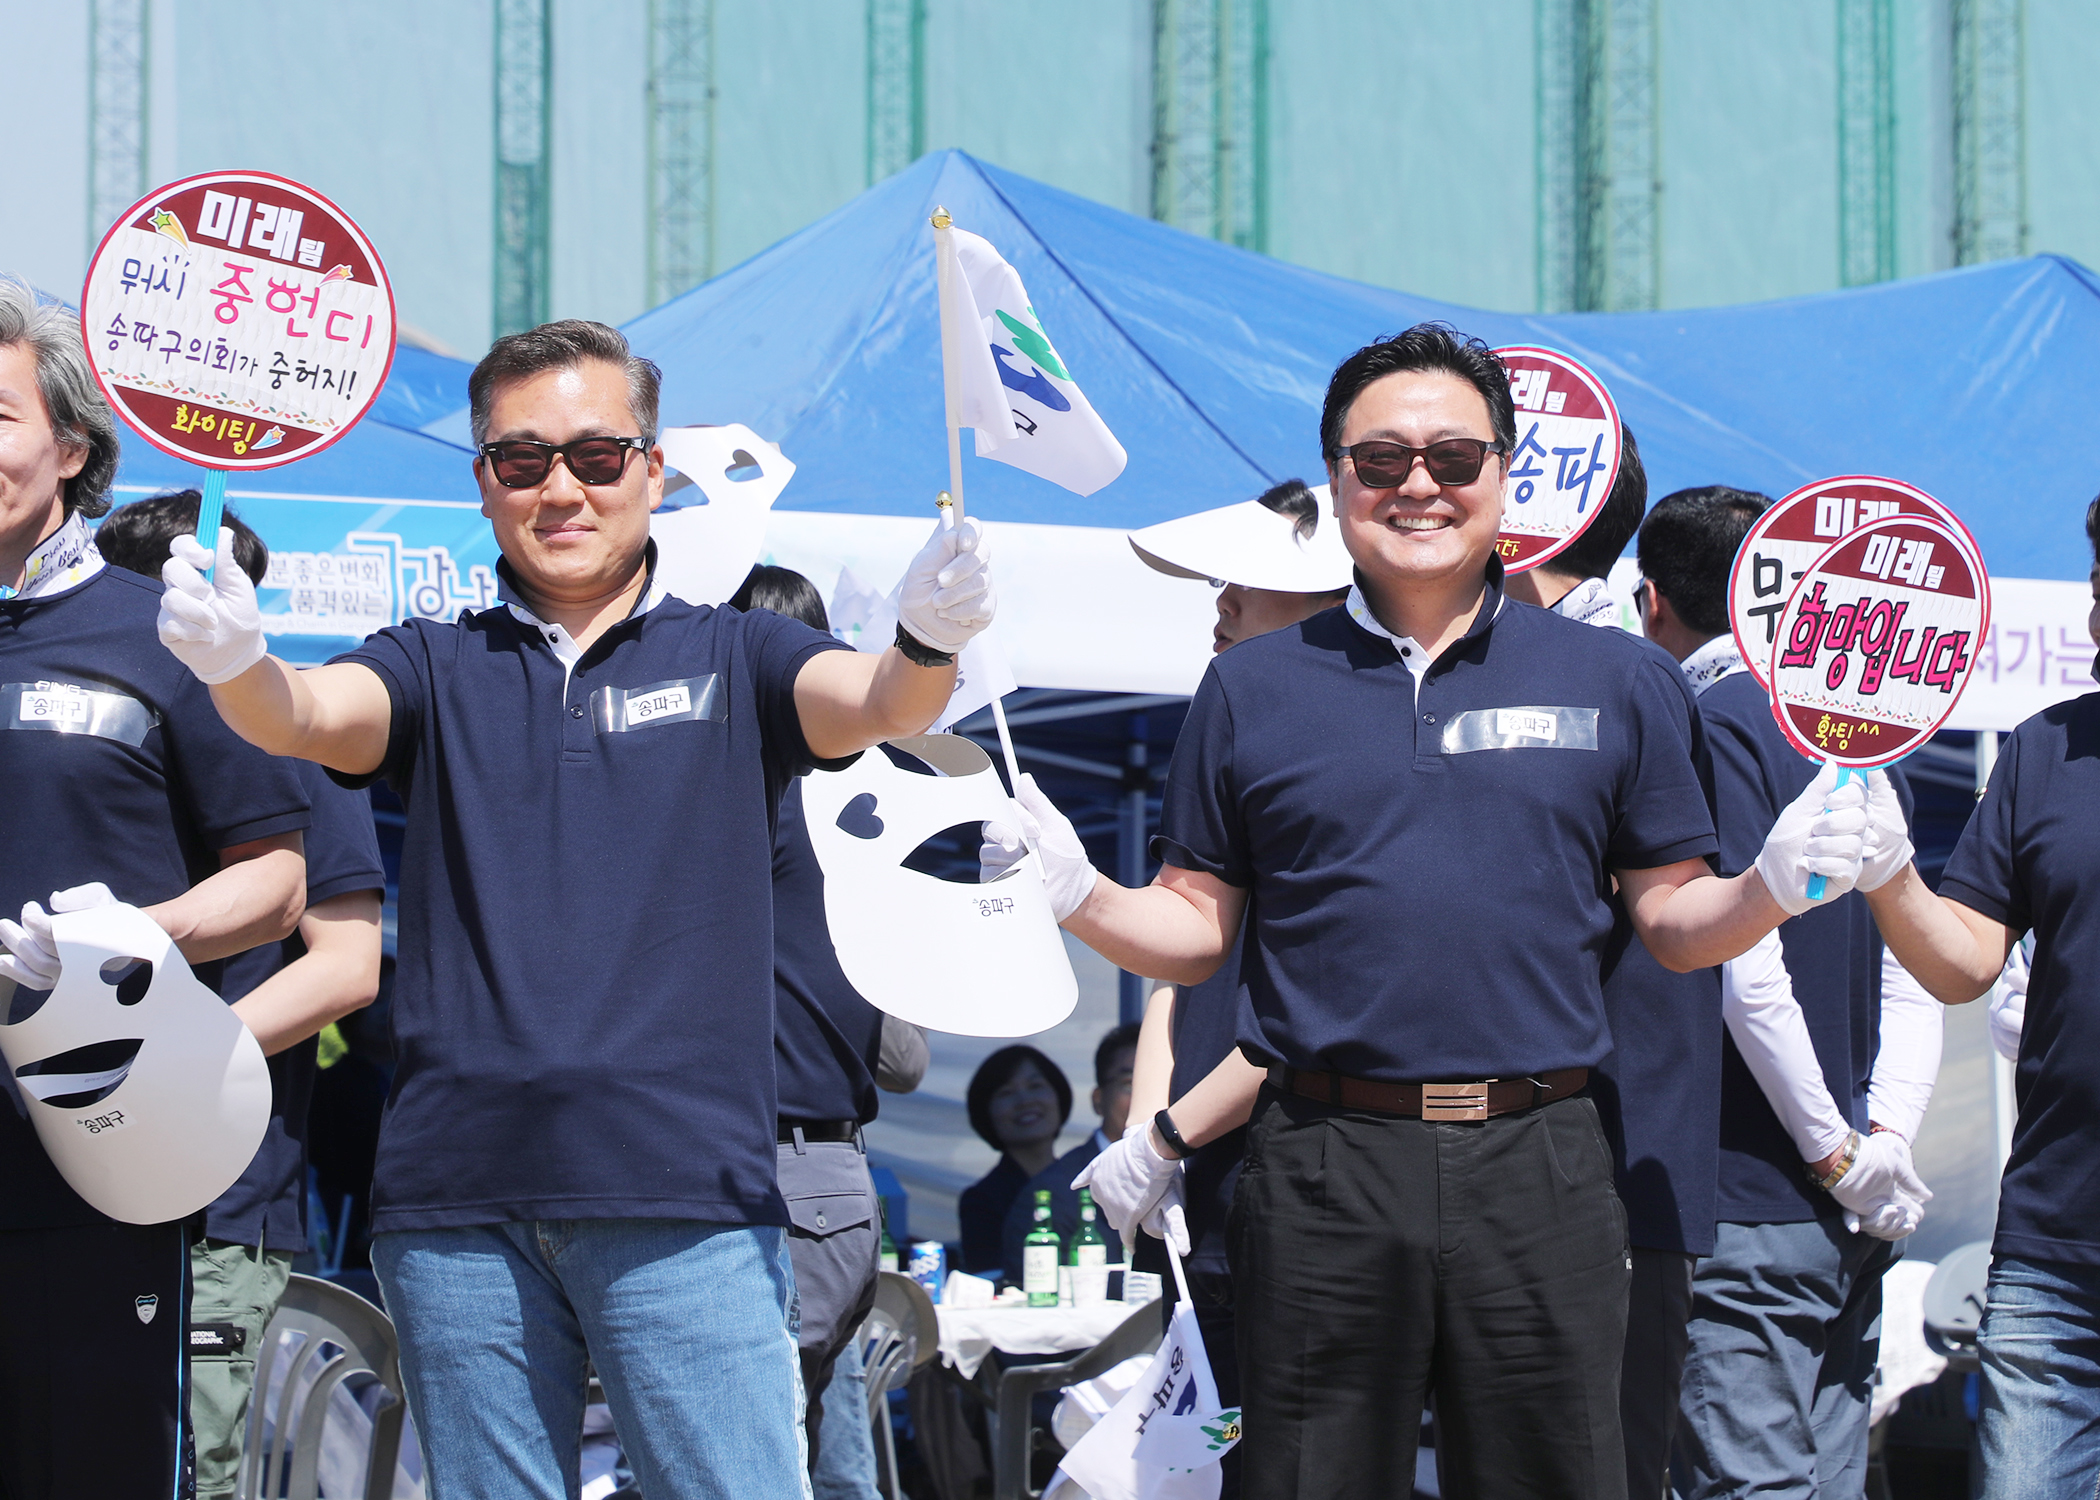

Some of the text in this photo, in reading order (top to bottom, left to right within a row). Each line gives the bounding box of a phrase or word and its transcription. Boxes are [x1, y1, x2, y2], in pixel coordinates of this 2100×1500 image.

[1506, 367, 1568, 414] 래팀
[171, 404, 256, 455] 화이팅
[1508, 421, 1607, 514] 송파
[294, 558, 336, 584] 좋은
[339, 559, 381, 587] 변화
[295, 588, 386, 616] 품격 있는
[1779, 581, 1971, 695] 희망입니다
[33, 697, 82, 718] 송파구
[637, 692, 685, 717] 송파구
[1508, 714, 1551, 735] 송파구
[979, 897, 1014, 917] 송파구
[84, 1110, 125, 1134] 송파구
